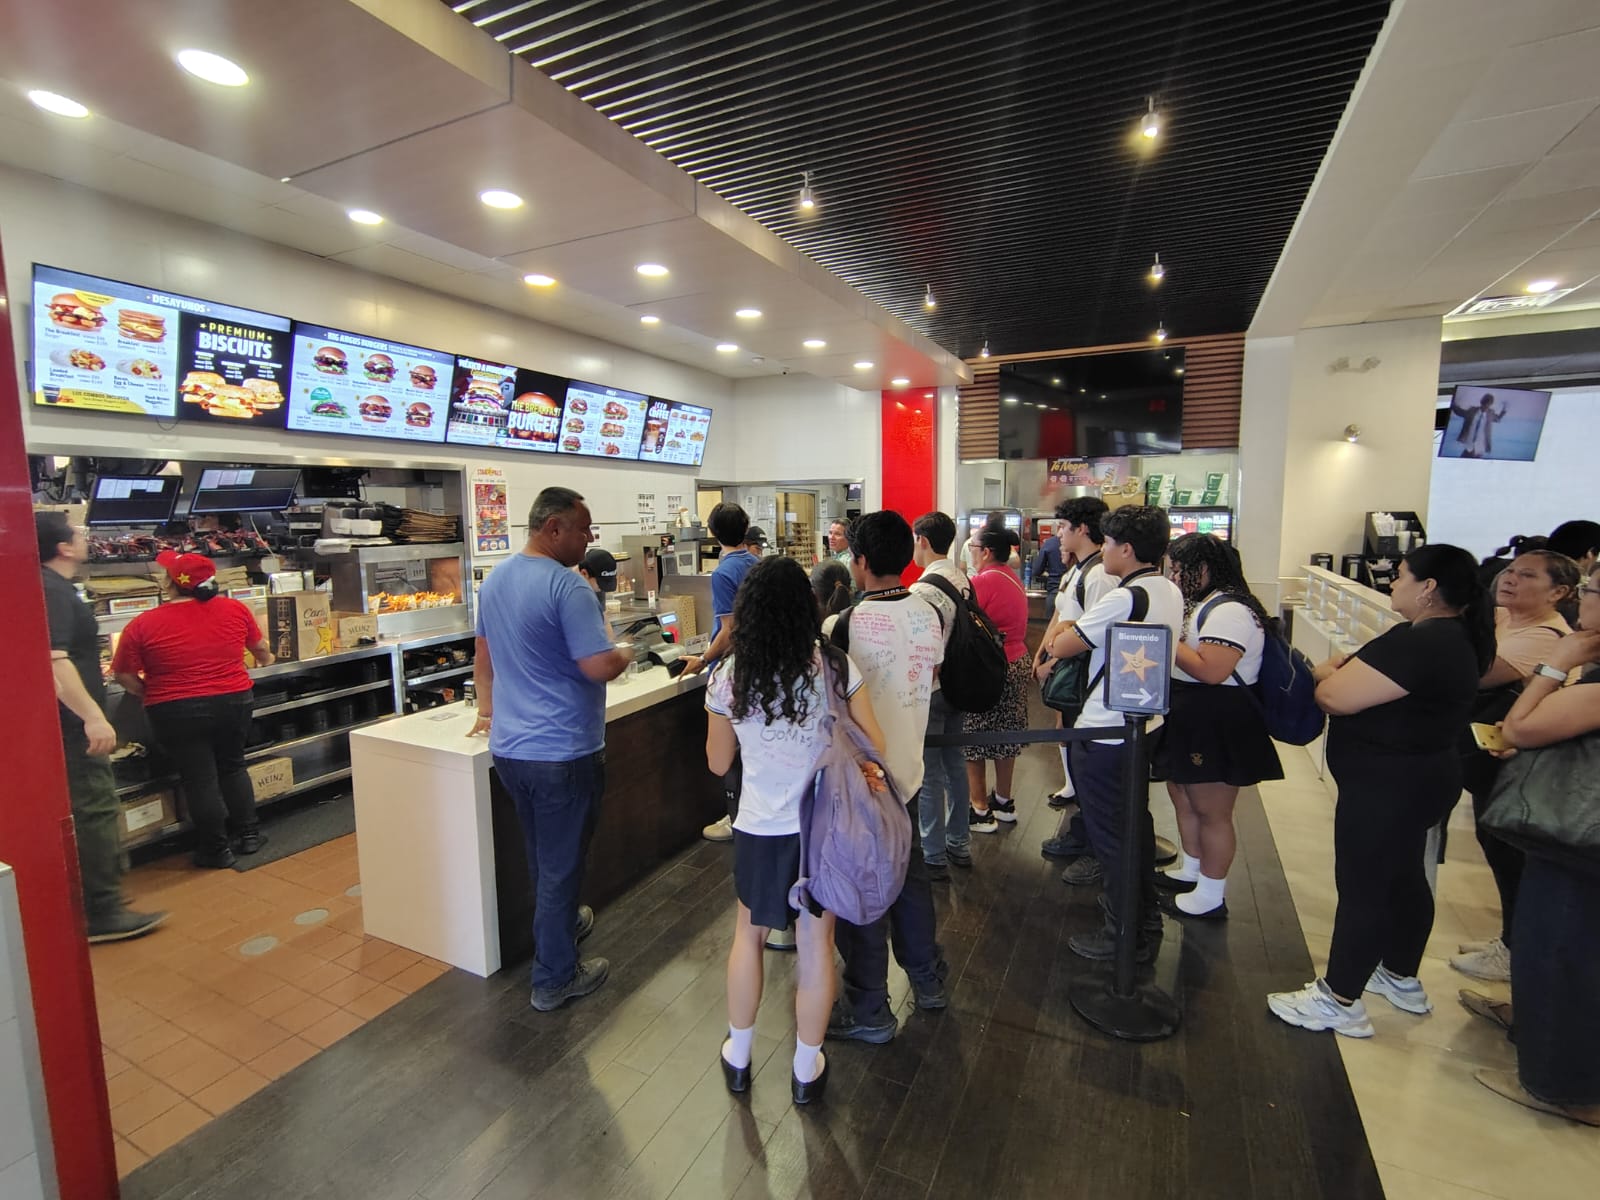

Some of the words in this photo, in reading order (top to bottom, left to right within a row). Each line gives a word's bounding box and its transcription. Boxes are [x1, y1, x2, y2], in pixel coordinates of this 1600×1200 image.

[152, 293, 206, 313] DESAYUNOS
[208, 321, 265, 342] PREMIUM
[198, 331, 273, 360] BISCUITS
[511, 400, 525, 412] THE
[525, 402, 562, 416] BREAKFAST
[507, 411, 561, 434] BURGER
[1060, 461, 1089, 474] Negro
[348, 623, 371, 635] HEINZ
[1118, 632, 1160, 642] Bienvenido
[257, 773, 285, 788] HEINZ
